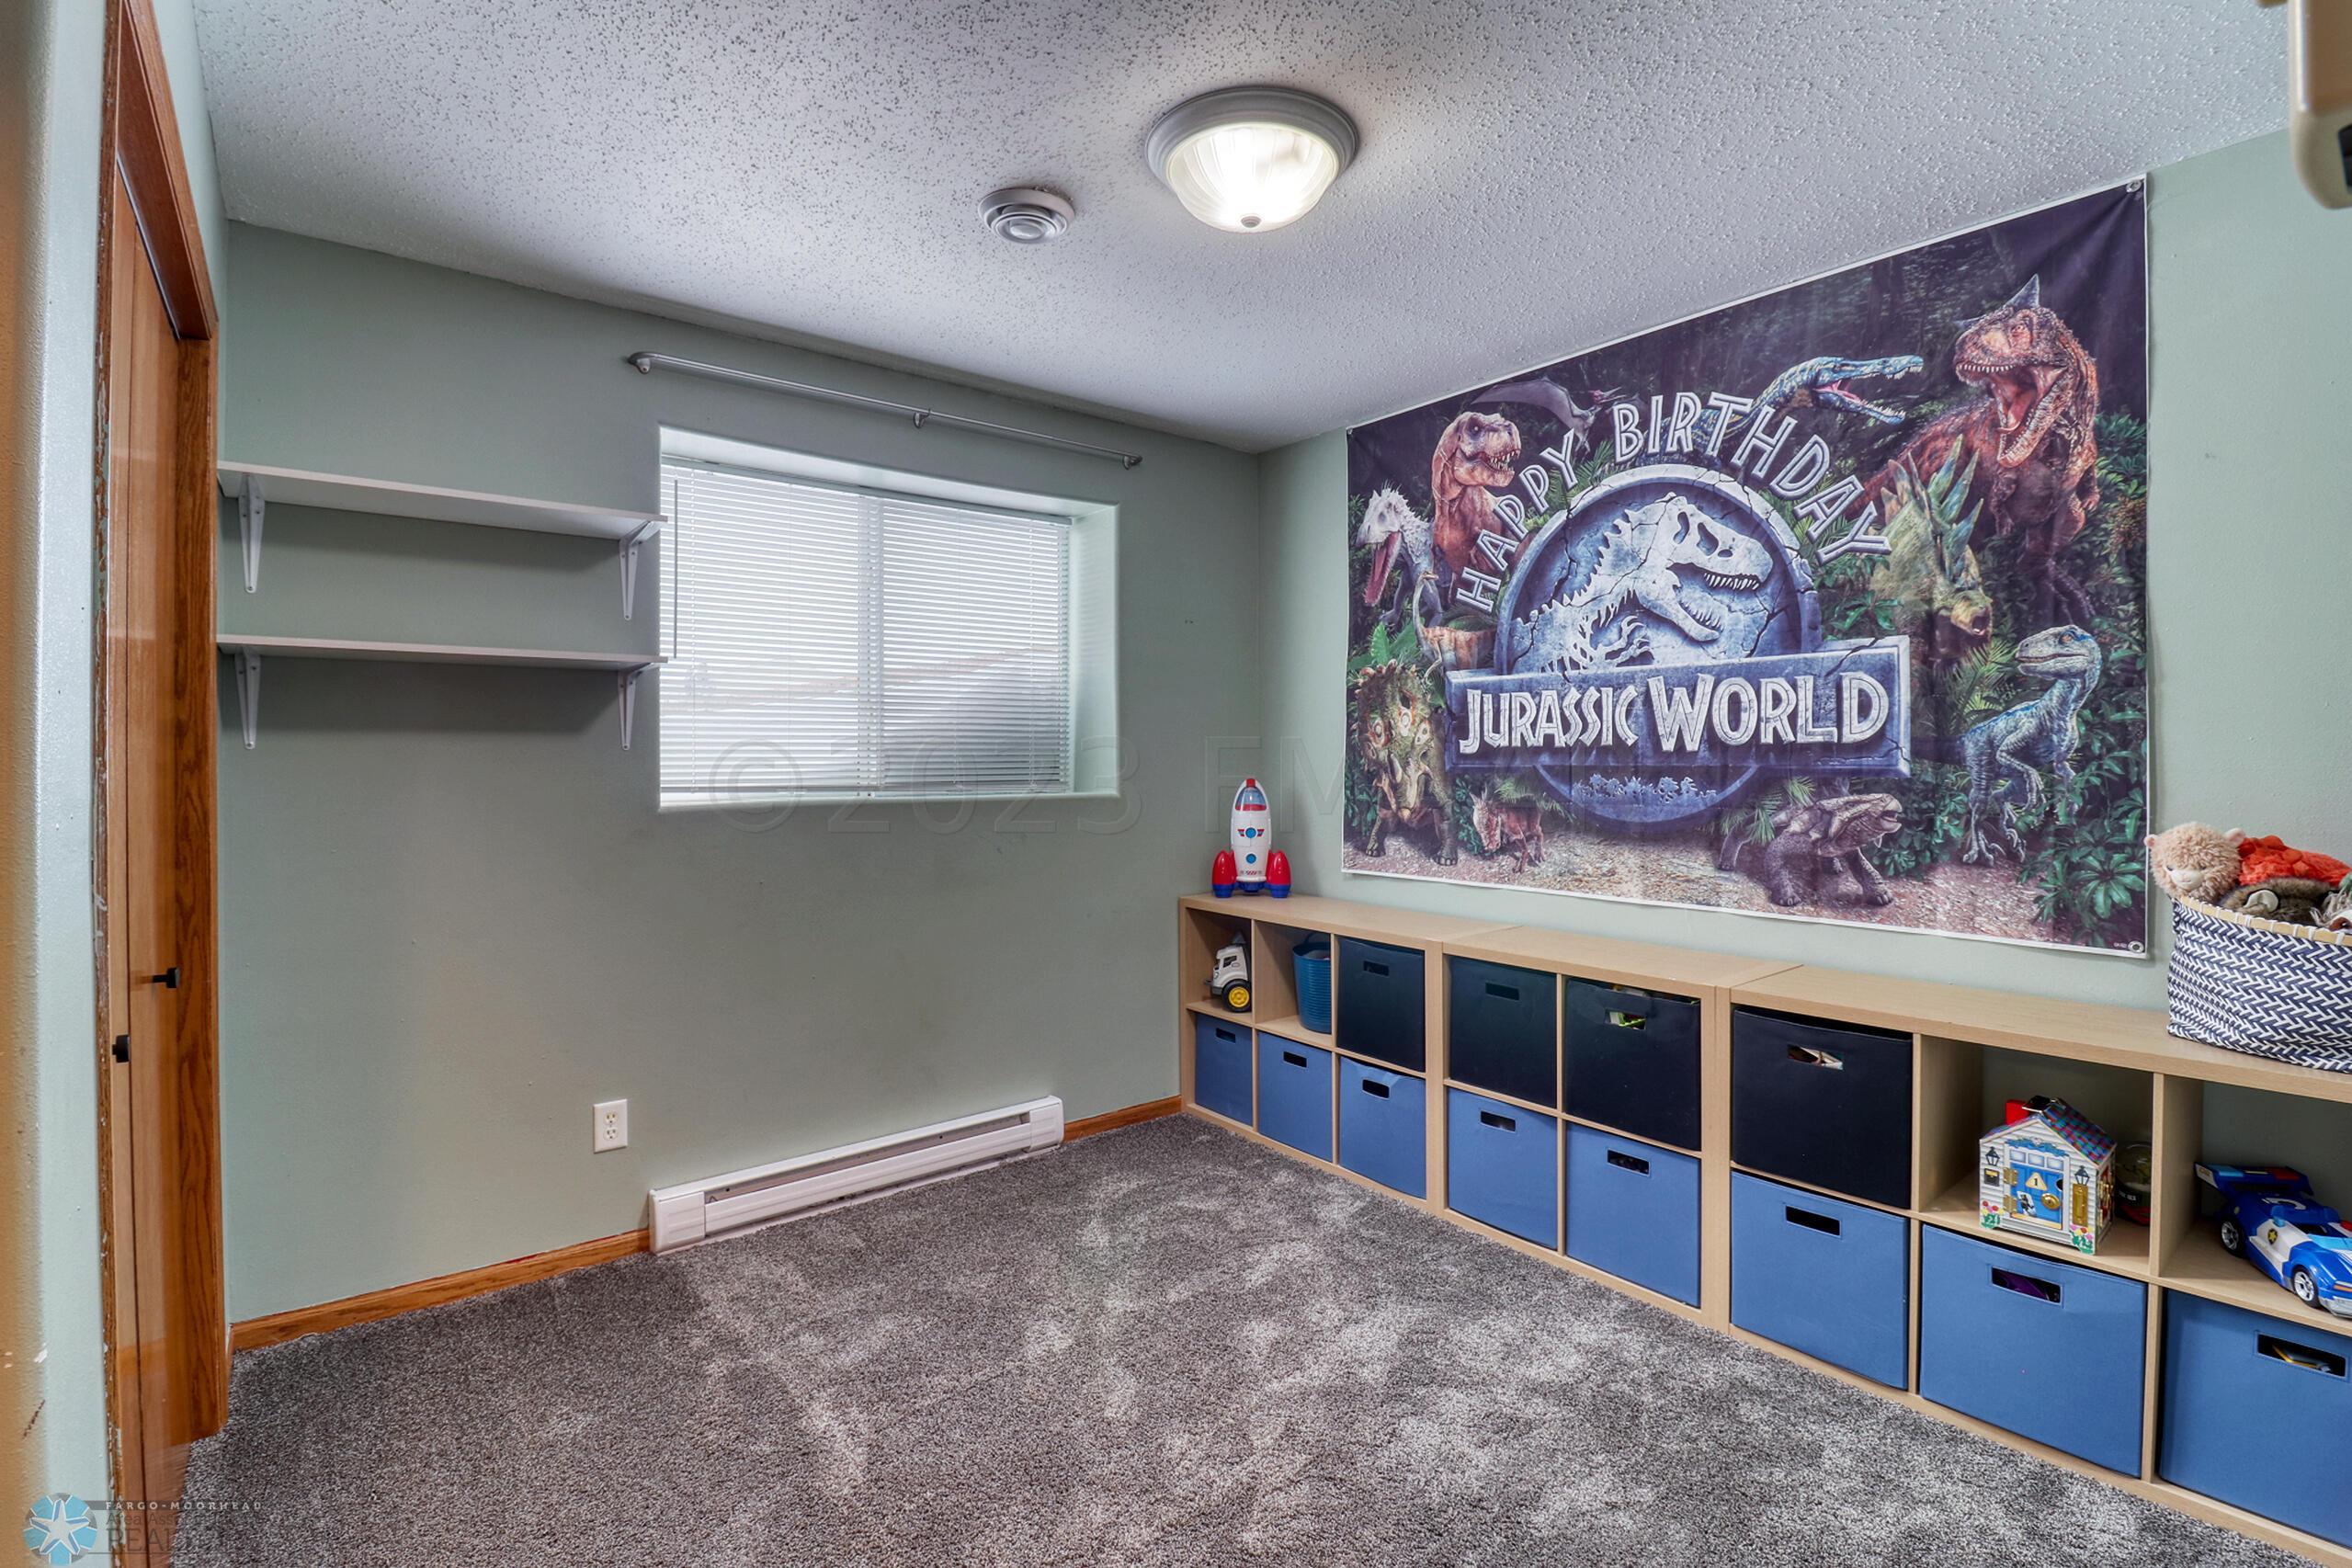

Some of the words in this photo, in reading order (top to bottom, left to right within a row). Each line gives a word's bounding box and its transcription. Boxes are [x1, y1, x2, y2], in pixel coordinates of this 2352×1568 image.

[1457, 429, 1580, 613] HAPPY
[1612, 392, 1892, 566] BIRTHDAY
[1460, 684, 1639, 754] JURASSIC
[1648, 672, 1890, 752] WORLD
